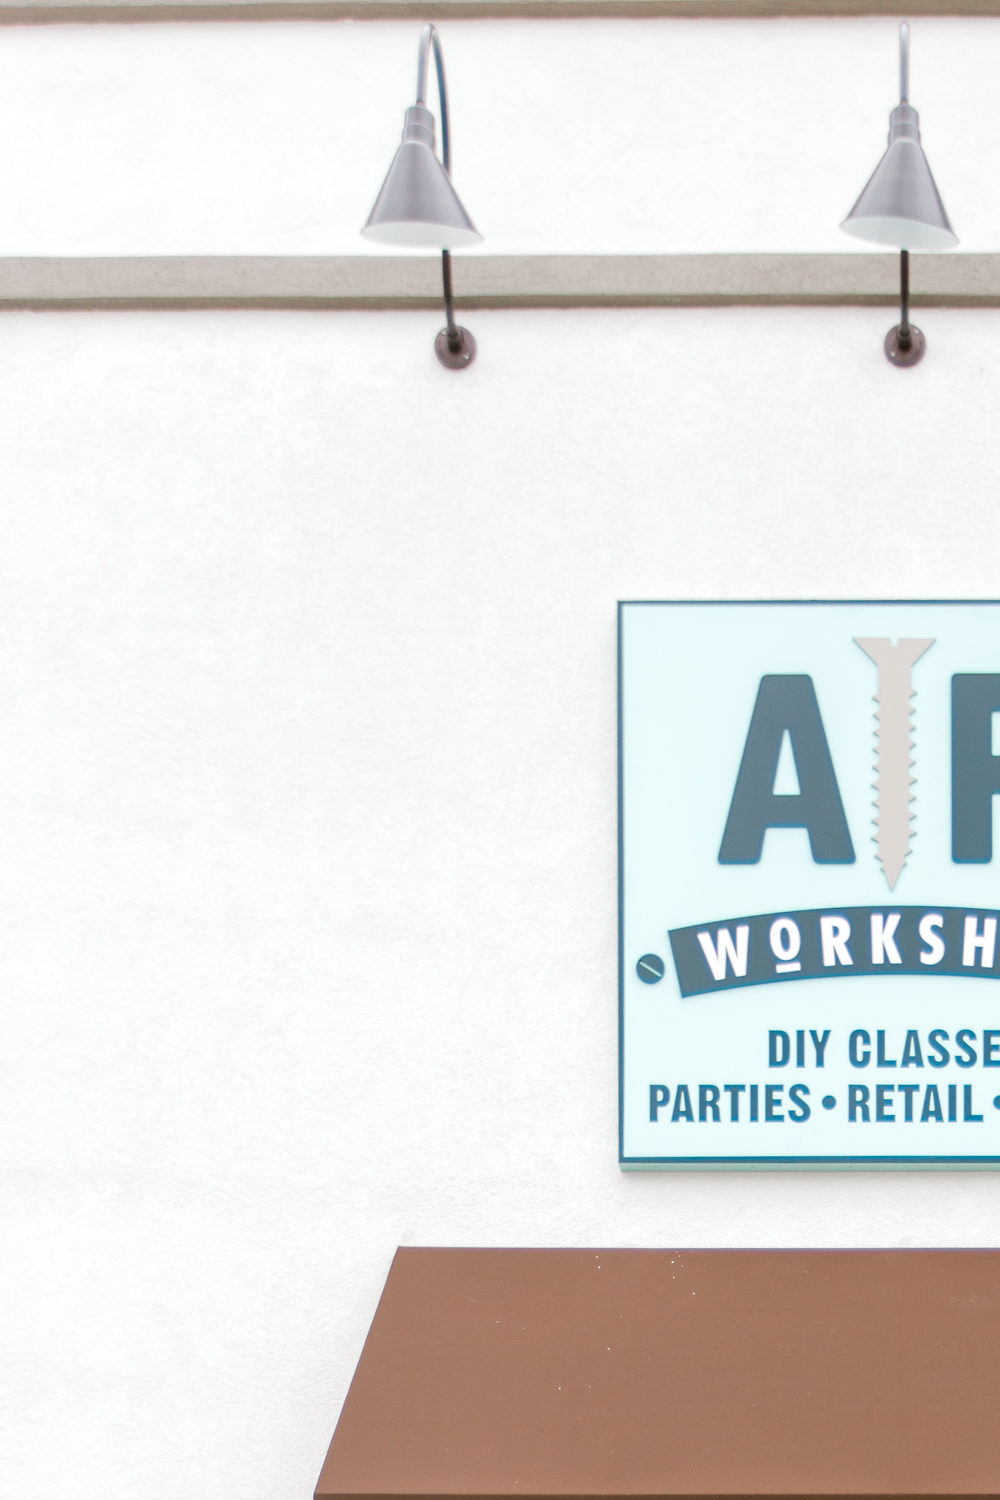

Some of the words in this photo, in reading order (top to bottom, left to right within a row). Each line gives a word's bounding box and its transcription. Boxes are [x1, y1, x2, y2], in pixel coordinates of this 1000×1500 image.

[768, 1029, 832, 1069] DIY
[649, 1084, 812, 1124] PARTIES
[847, 1084, 984, 1124] RETAIL
